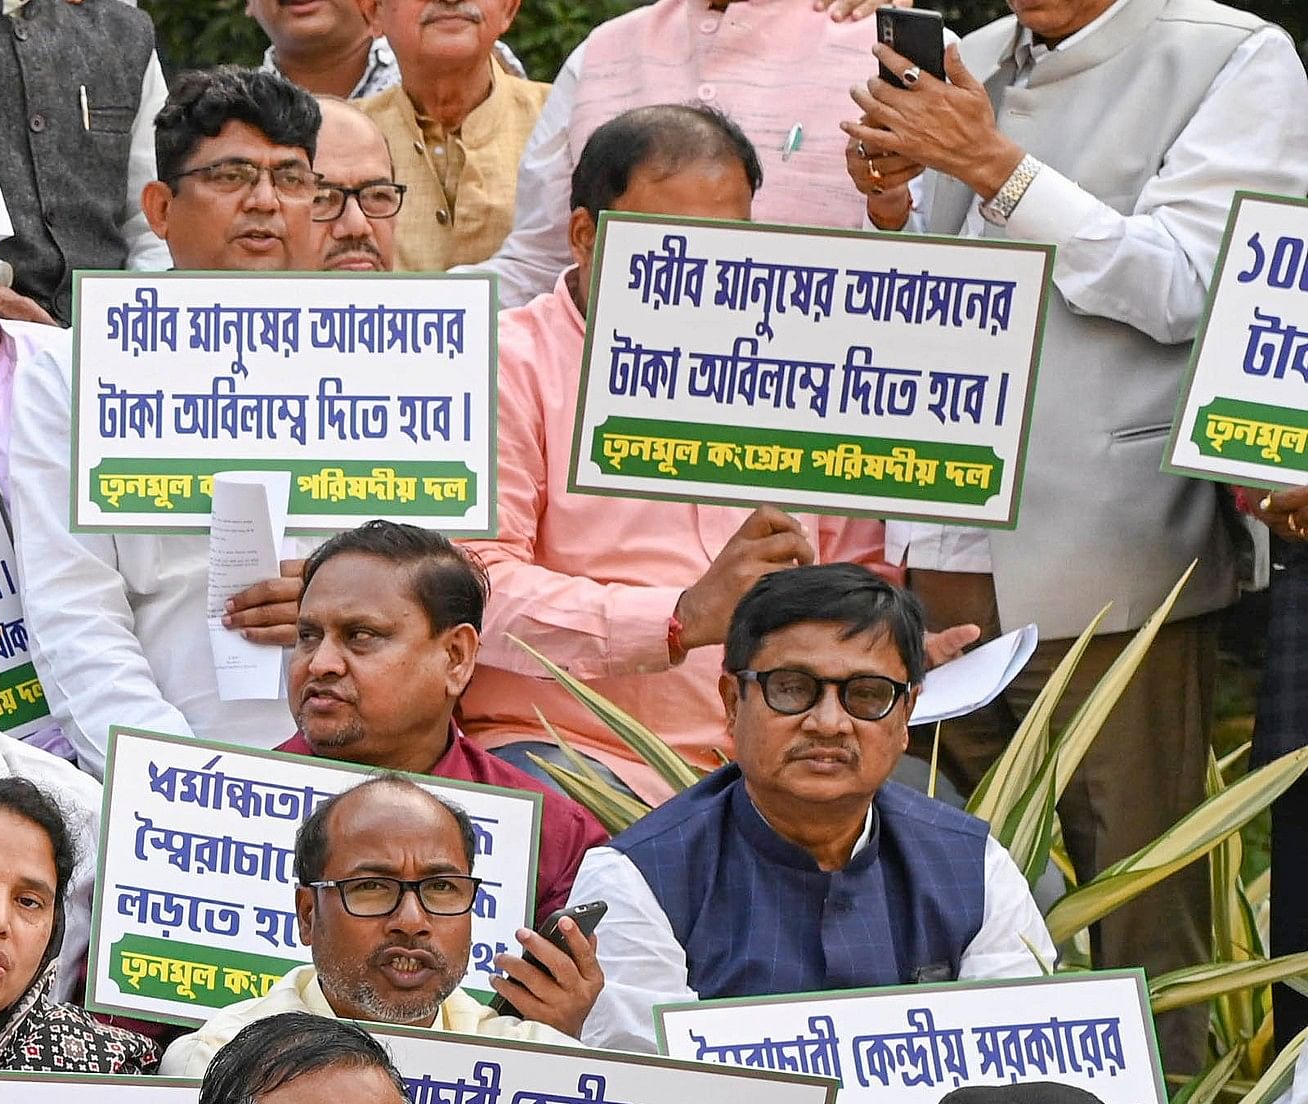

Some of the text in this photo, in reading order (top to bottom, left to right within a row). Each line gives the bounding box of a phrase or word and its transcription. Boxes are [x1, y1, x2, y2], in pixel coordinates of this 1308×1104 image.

[627, 235, 1015, 342] গরীব মানুষের আবাসনের
[106, 287, 464, 379] গরীব মানুষের আবাসনের
[97, 383, 163, 440] টাকা
[172, 376, 309, 446] অবিলম্বে
[316, 377, 389, 441] দিতে
[396, 395, 450, 443] হবে
[608, 335, 680, 400] টাকা
[688, 336, 836, 419] অবিলম্বে
[838, 346, 919, 417] দিতে
[928, 371, 987, 425] হবে
[297, 467, 465, 501] পরিষদীয় দল
[705, 441, 802, 473] কংগ্রেস
[810, 443, 937, 486] পরিষদীয়
[944, 461, 991, 489] দল
[114, 884, 243, 939] লড়তে
[851, 1007, 1124, 1089] কেন্দ্রীয় সরকারের
